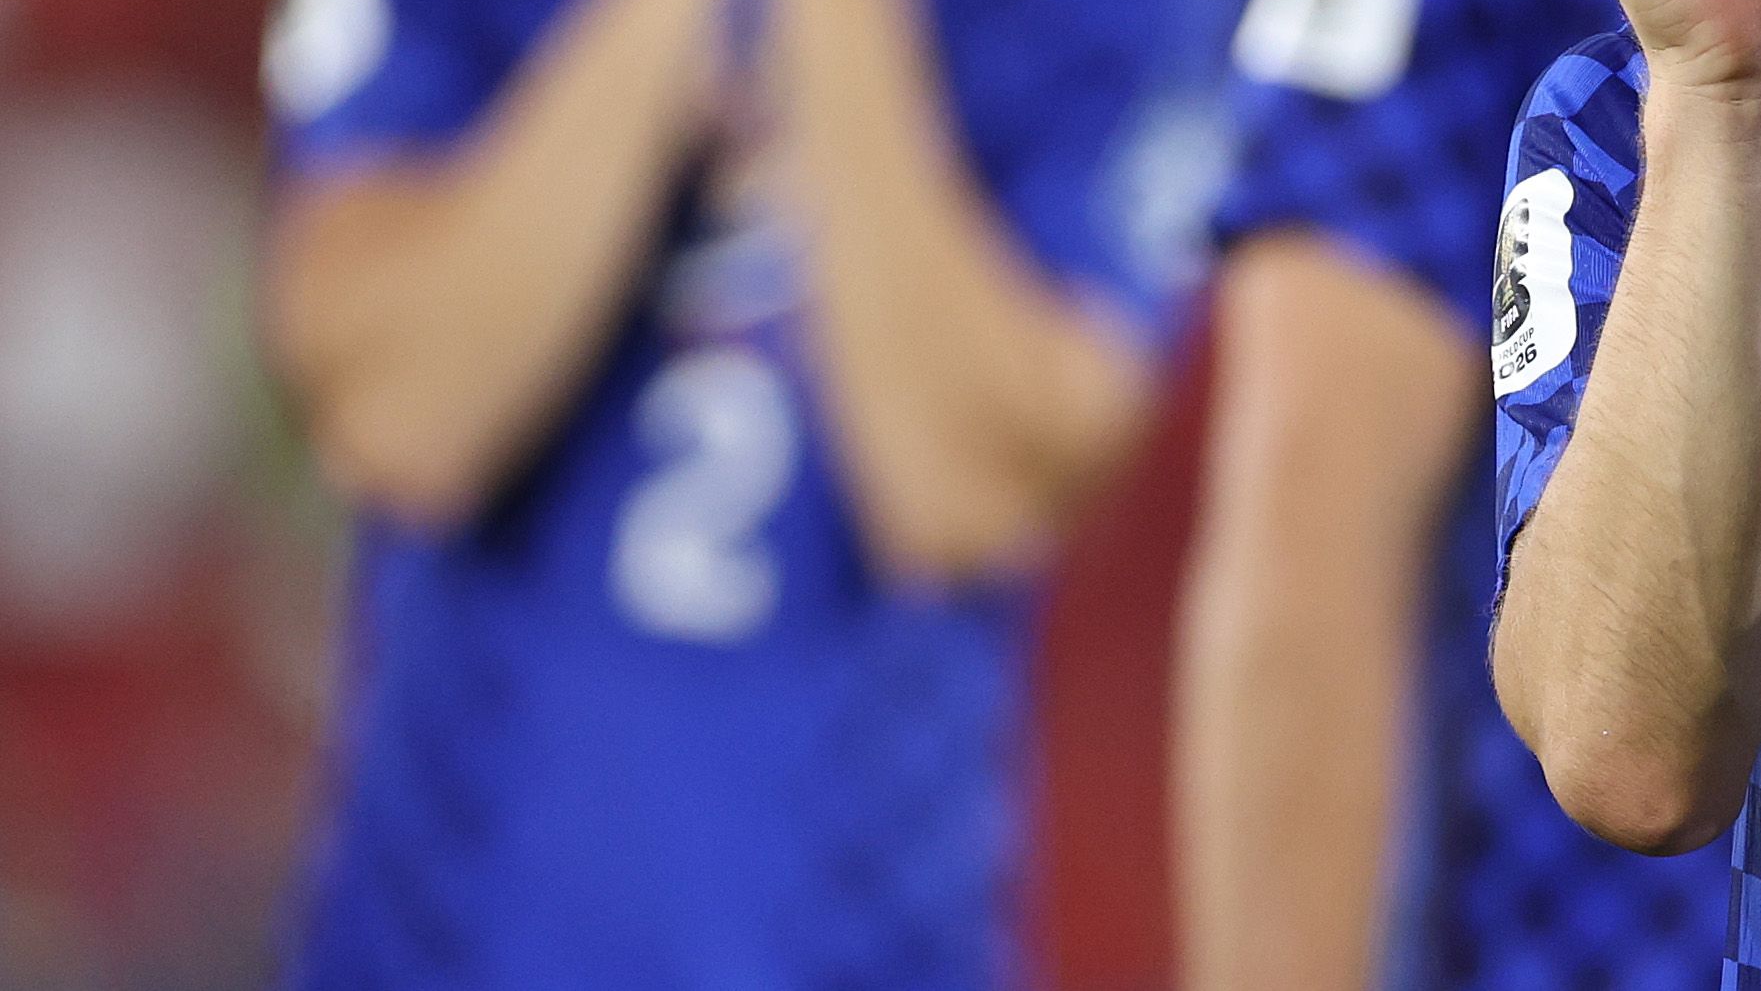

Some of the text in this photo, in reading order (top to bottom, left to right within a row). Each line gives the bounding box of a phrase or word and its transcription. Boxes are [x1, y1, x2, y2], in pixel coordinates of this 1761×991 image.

[1501, 304, 1520, 333] FIFA
[1519, 327, 1535, 346] CUP
[1499, 343, 1538, 380] 026
[612, 352, 792, 640] 2
